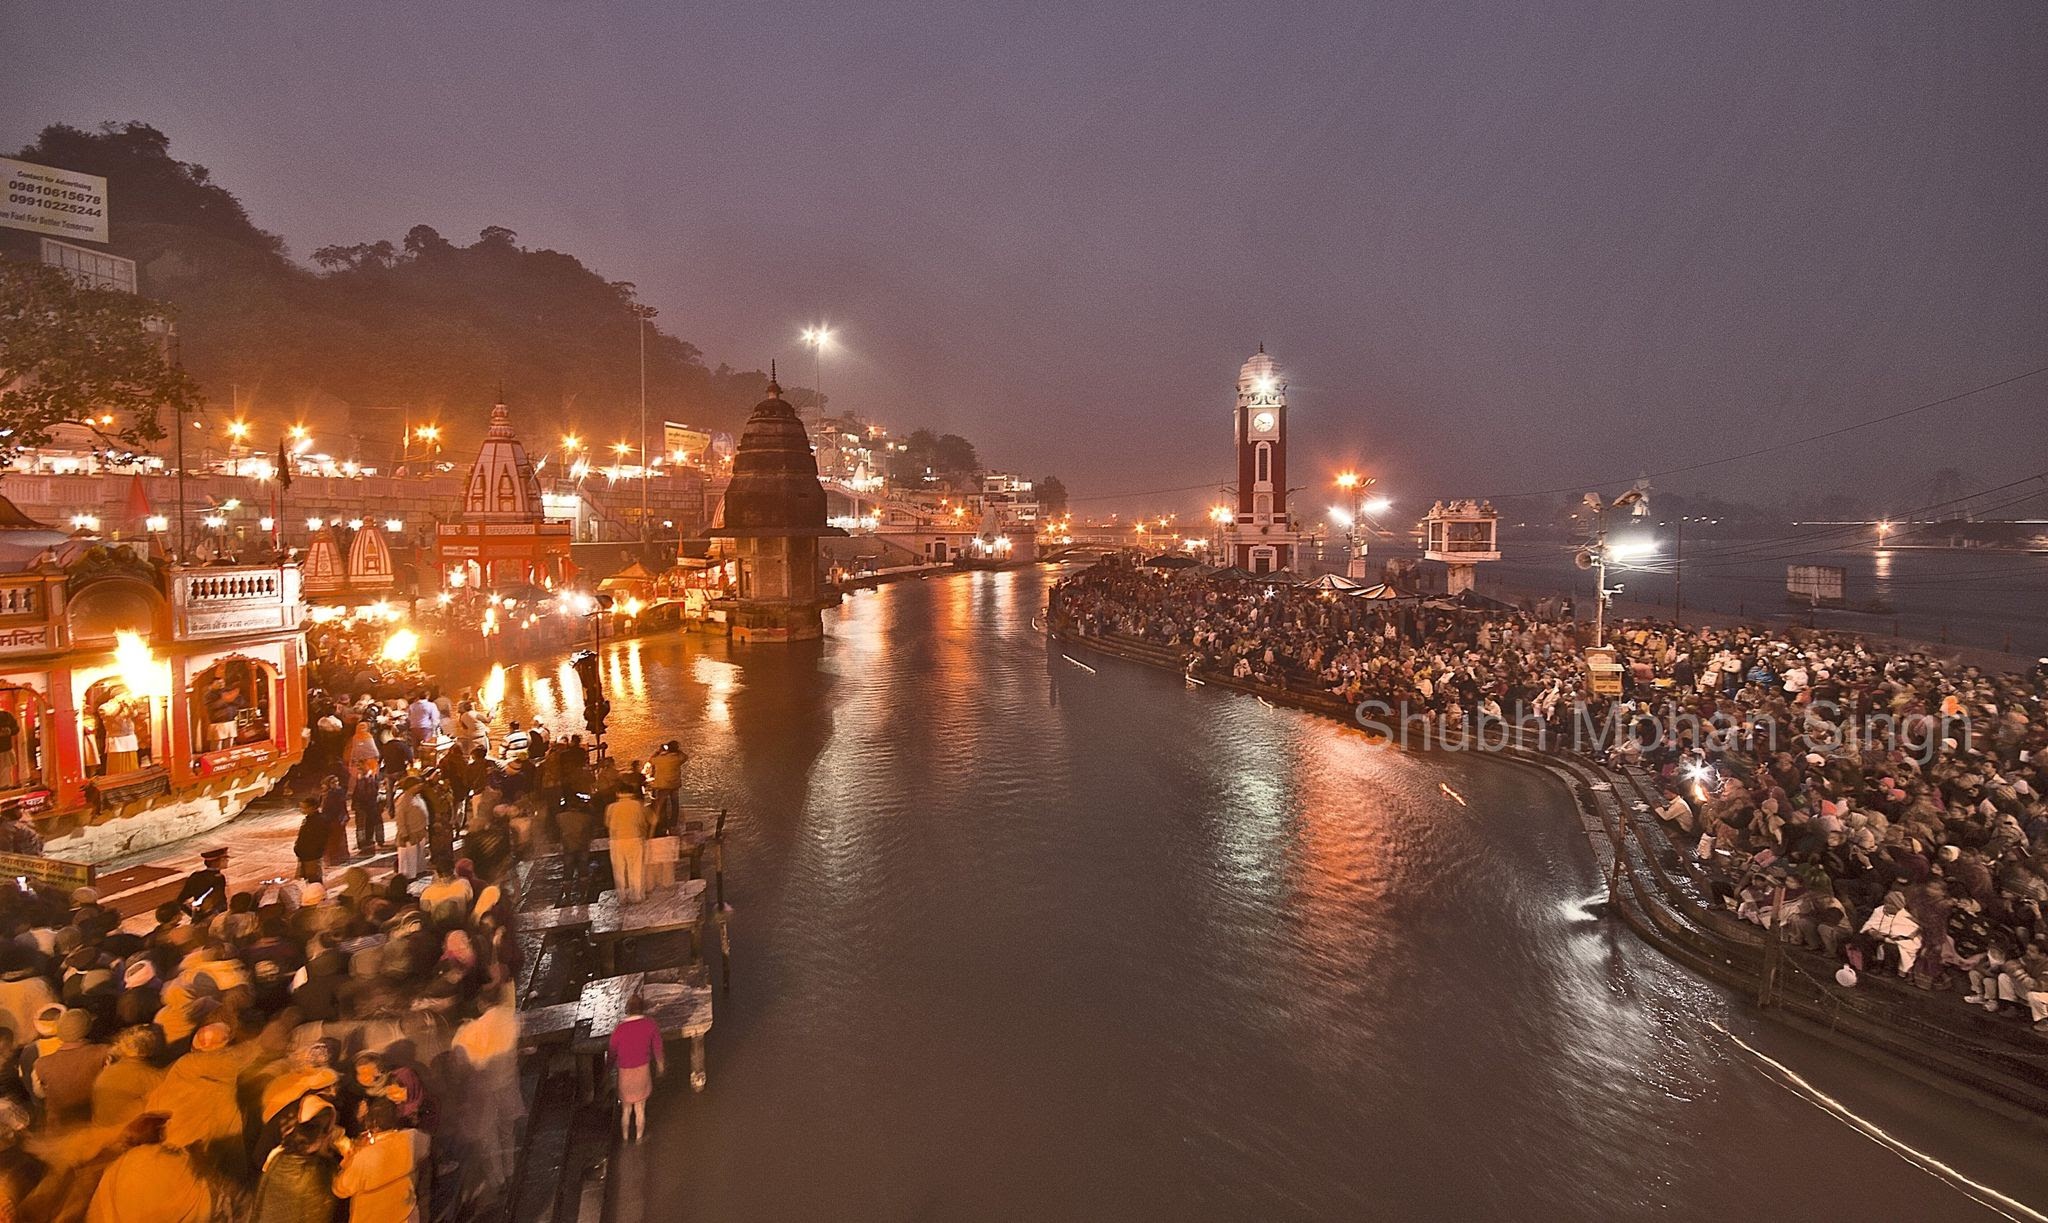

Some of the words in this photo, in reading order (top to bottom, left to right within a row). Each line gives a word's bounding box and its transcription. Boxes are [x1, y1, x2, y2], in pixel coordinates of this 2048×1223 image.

[9, 180, 101, 205] 09810615678
[17, 170, 43, 181] Contact
[45, 175, 54, 183] for
[55, 178, 91, 191] Advertising
[9, 193, 102, 218] 09910225244
